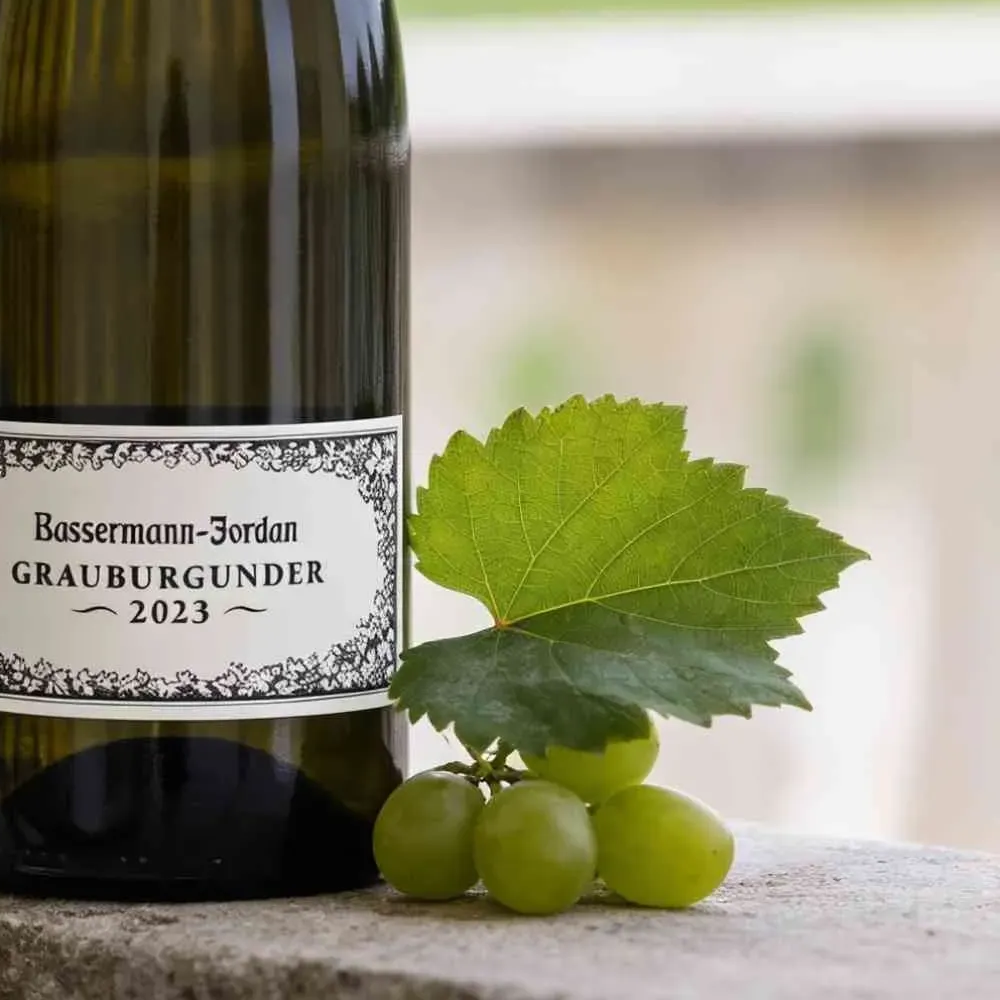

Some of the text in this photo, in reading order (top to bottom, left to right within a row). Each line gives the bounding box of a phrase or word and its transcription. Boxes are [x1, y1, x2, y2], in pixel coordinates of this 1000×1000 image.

[34, 511, 298, 545] Bassermann-Jordan
[11, 560, 325, 589] GRAUBURGUNDER
[129, 600, 210, 624] 2023
